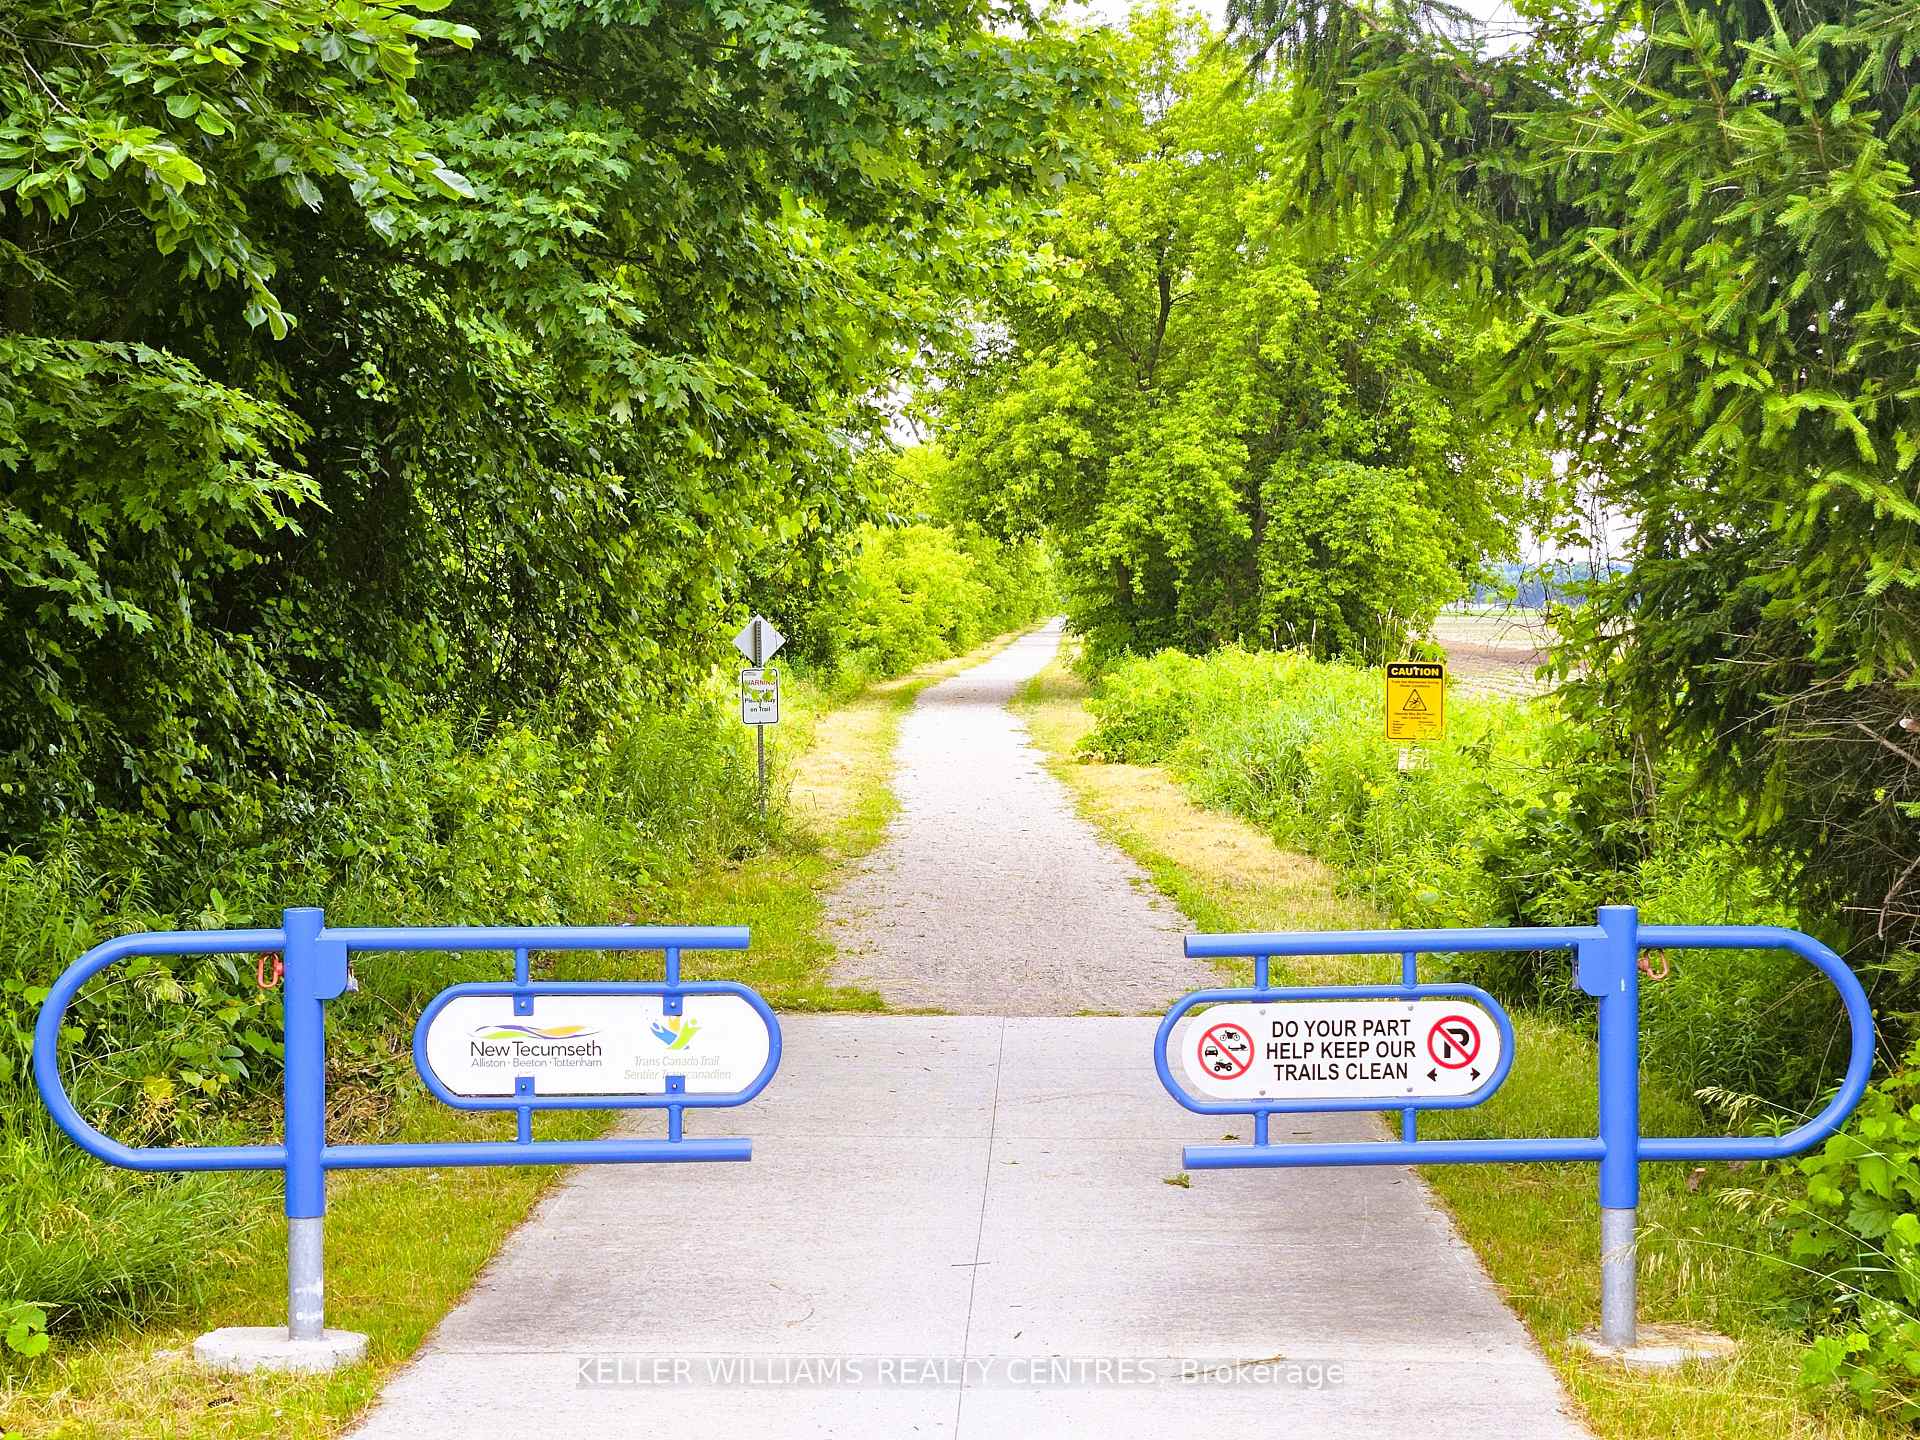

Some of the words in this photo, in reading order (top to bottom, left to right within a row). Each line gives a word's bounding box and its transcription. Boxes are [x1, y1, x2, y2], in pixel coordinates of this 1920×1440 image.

[1391, 667, 1439, 676] CAUTION
[1272, 1021, 1299, 1038] DO
[1304, 1020, 1357, 1037] YOUR
[1363, 1019, 1411, 1036] PART
[470, 1041, 510, 1057] New
[511, 1040, 602, 1057] Tecumseth
[1266, 1042, 1315, 1059] HELP
[1321, 1042, 1370, 1059] KEEP
[1376, 1041, 1417, 1058] OUR
[471, 1058, 506, 1068] Alliston
[512, 1058, 548, 1068] Beeton
[552, 1057, 603, 1068] Tottenham
[634, 1055, 660, 1067] Trans
[662, 1055, 698, 1067] Canada
[700, 1055, 720, 1067] Trail
[624, 1069, 660, 1080] Sentier
[1273, 1063, 1340, 1081] TRAILS
[1346, 1063, 1408, 1080] CLEAN
